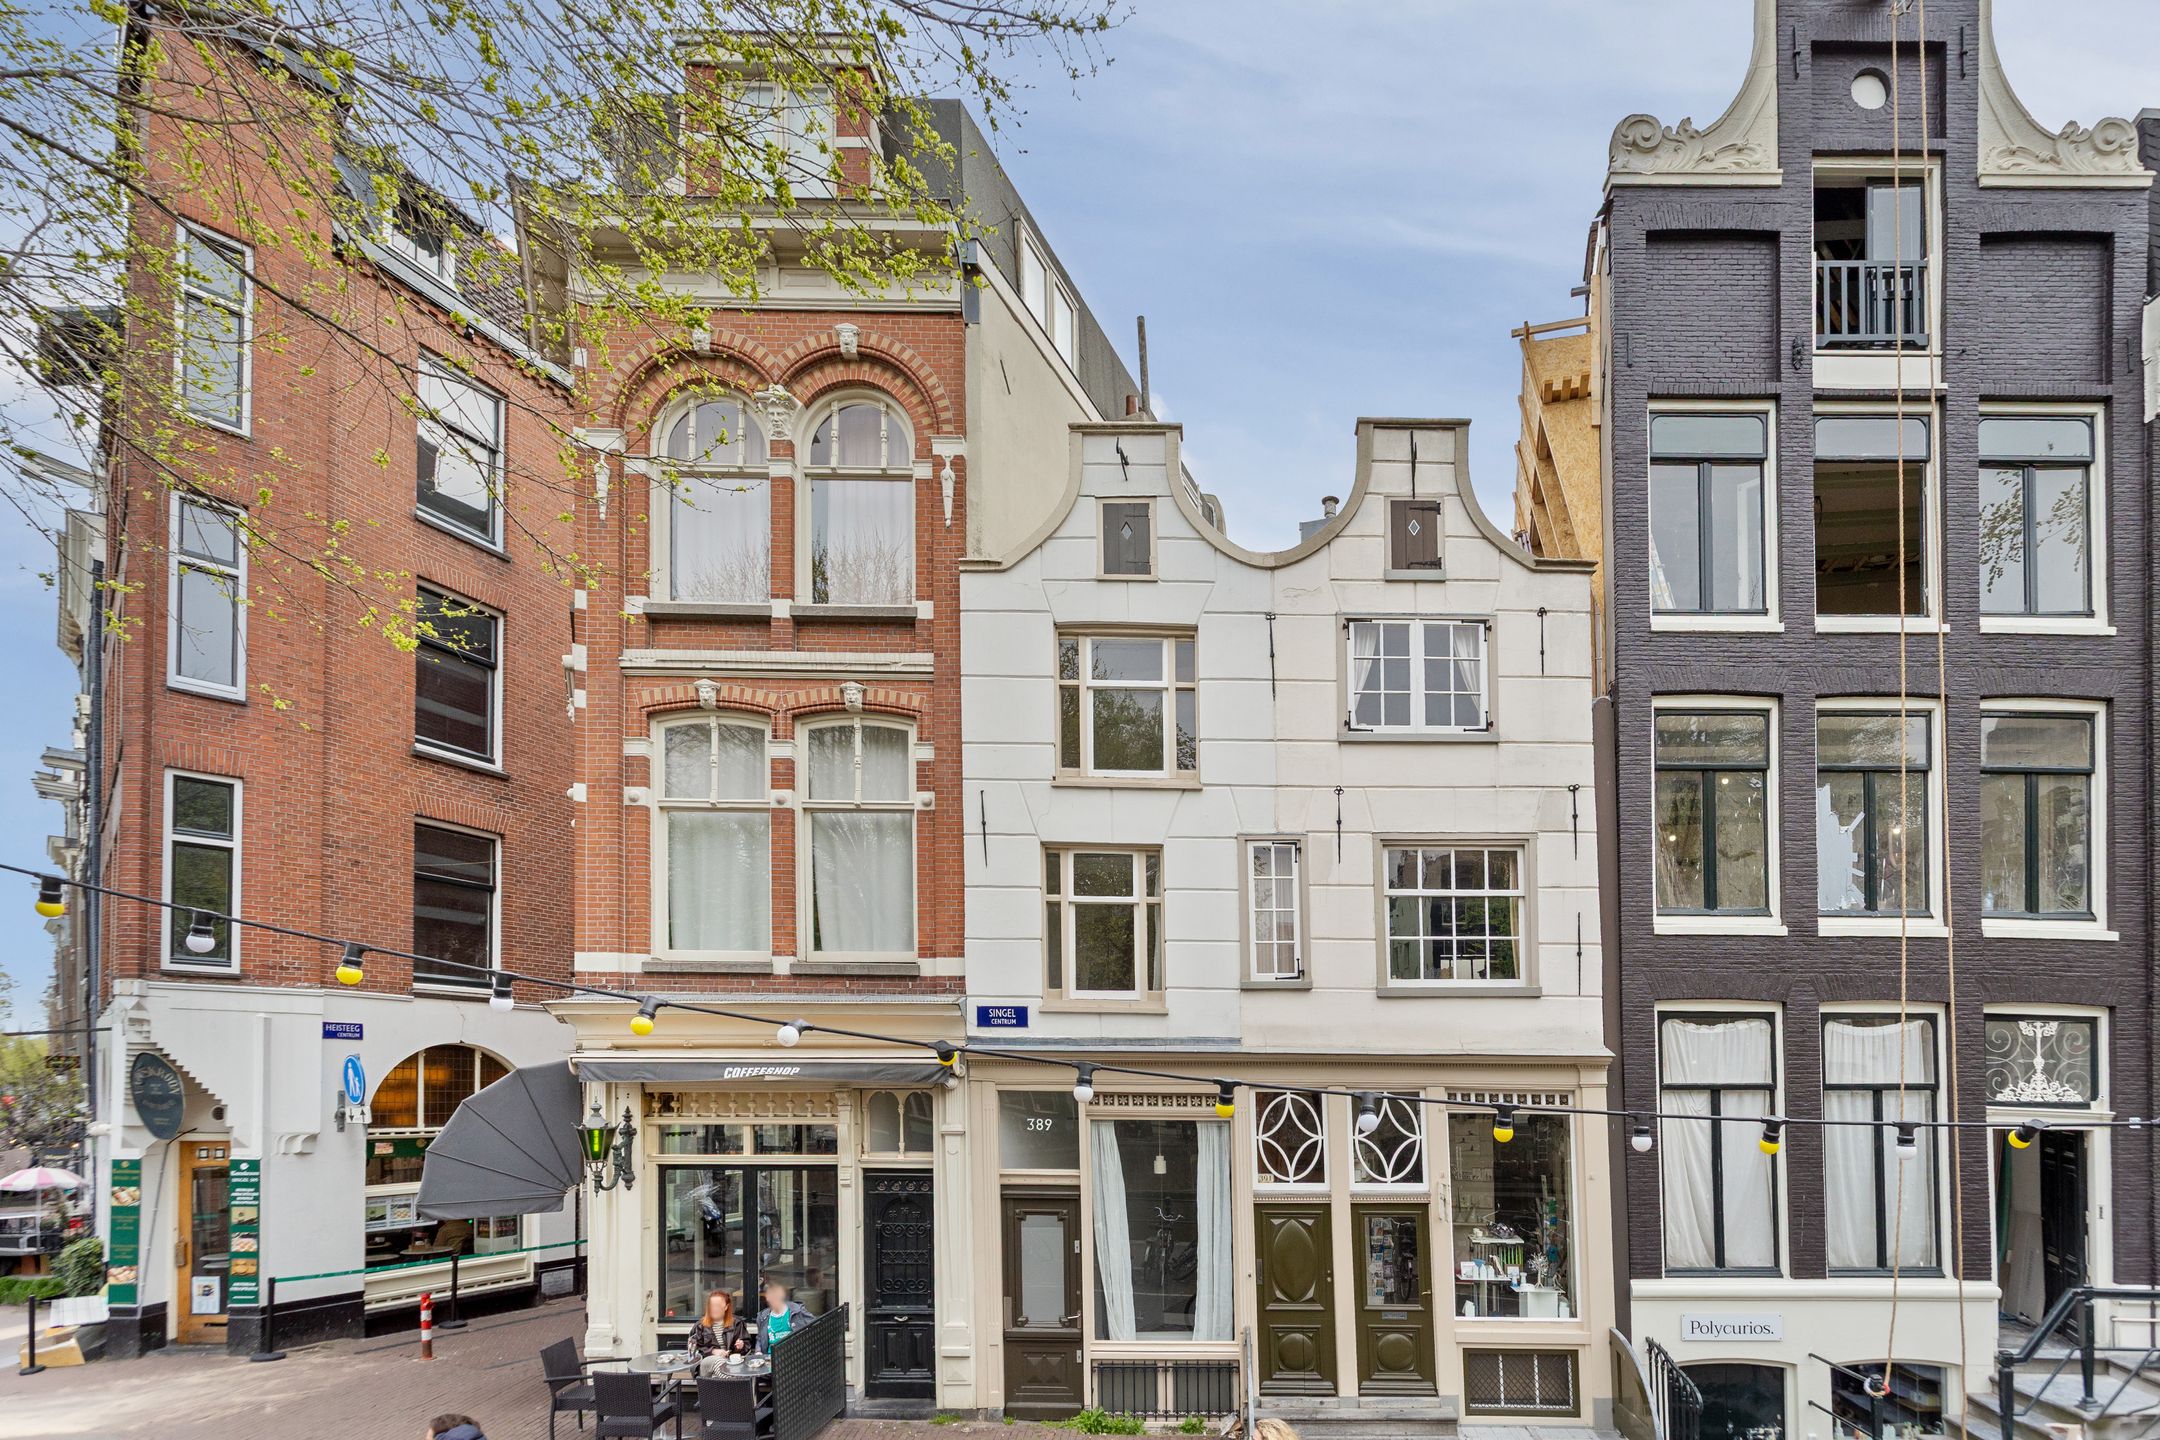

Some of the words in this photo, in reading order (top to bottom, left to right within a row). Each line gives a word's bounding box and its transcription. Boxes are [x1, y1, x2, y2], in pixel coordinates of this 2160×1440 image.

[989, 1008, 1016, 1018] SINGEL
[325, 1023, 361, 1033] HEISTEEG
[723, 1066, 801, 1079] COFFEESHOP
[1026, 1118, 1053, 1131] 389
[1690, 1320, 1774, 1338] Polycurios.
